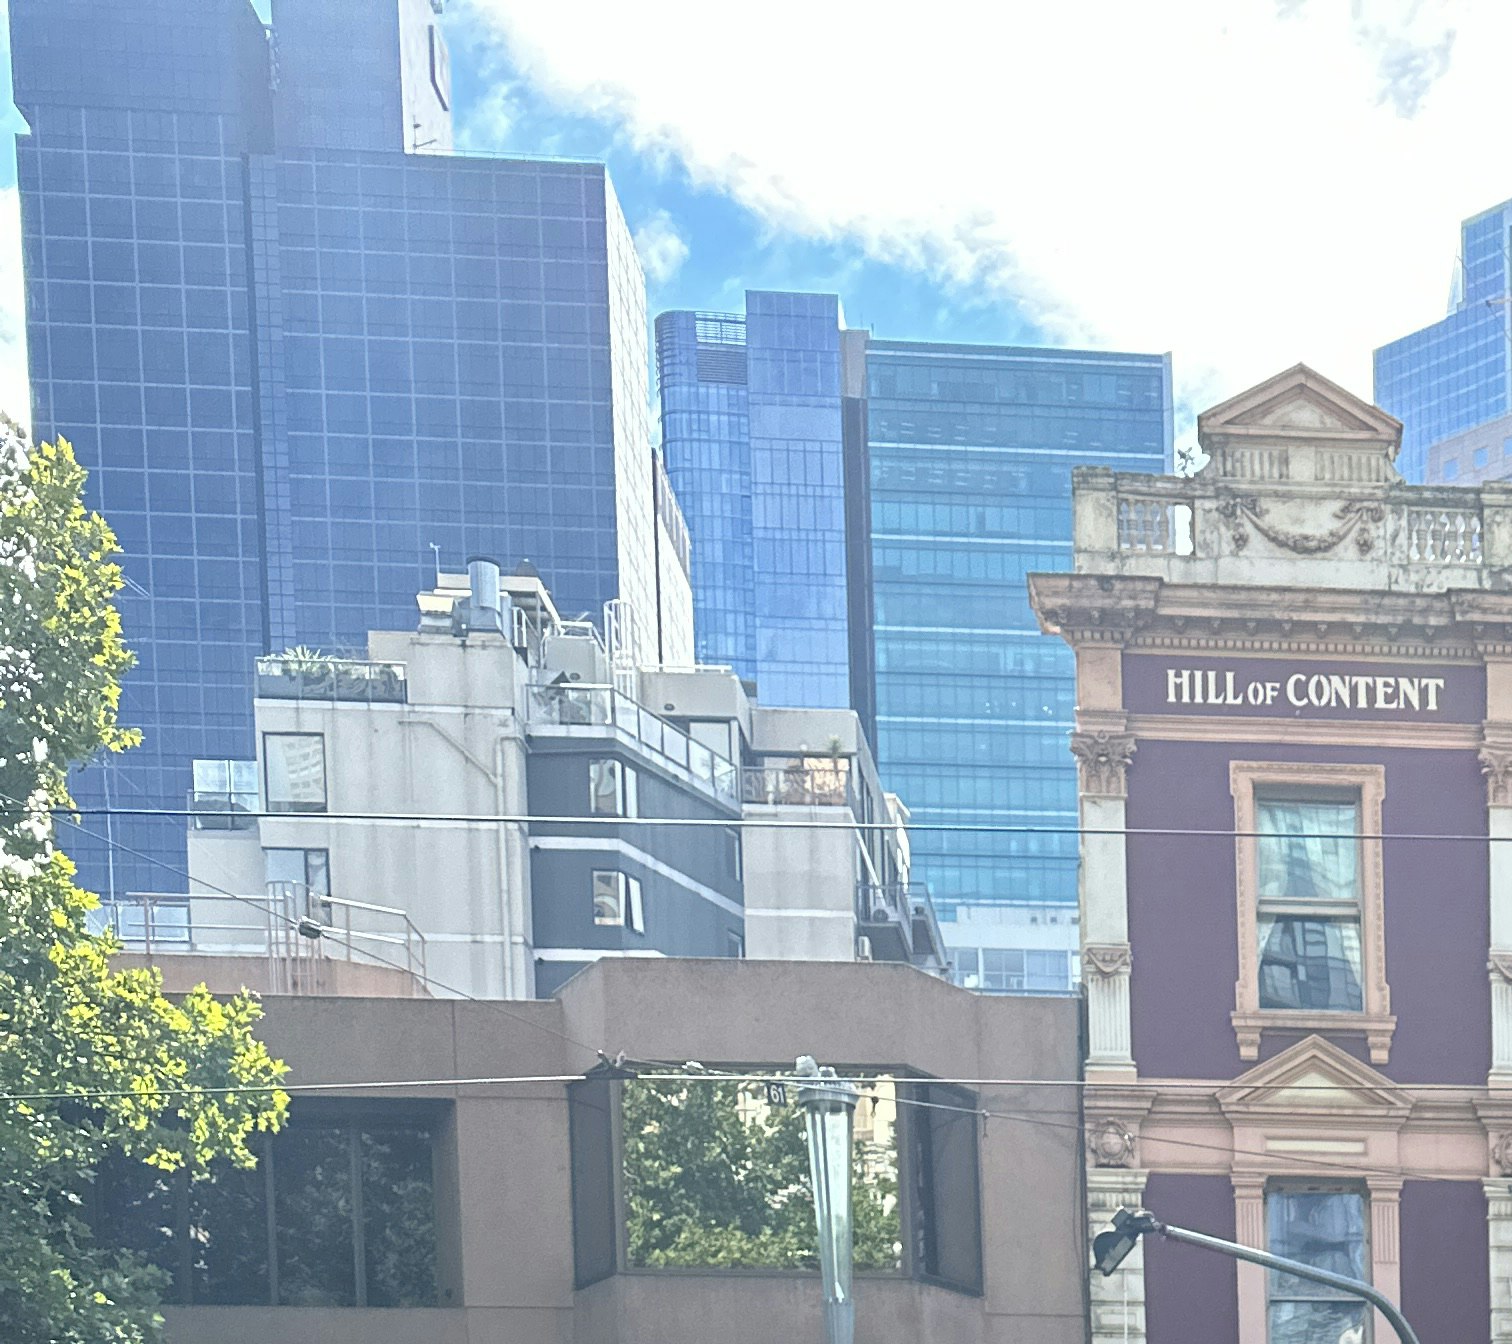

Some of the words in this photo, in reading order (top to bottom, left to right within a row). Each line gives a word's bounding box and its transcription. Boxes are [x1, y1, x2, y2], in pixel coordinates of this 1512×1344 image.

[1167, 669, 1243, 704] HILL
[1247, 682, 1280, 705] OF
[1286, 673, 1444, 711] CONTENT
[770, 1084, 785, 1104] 61
